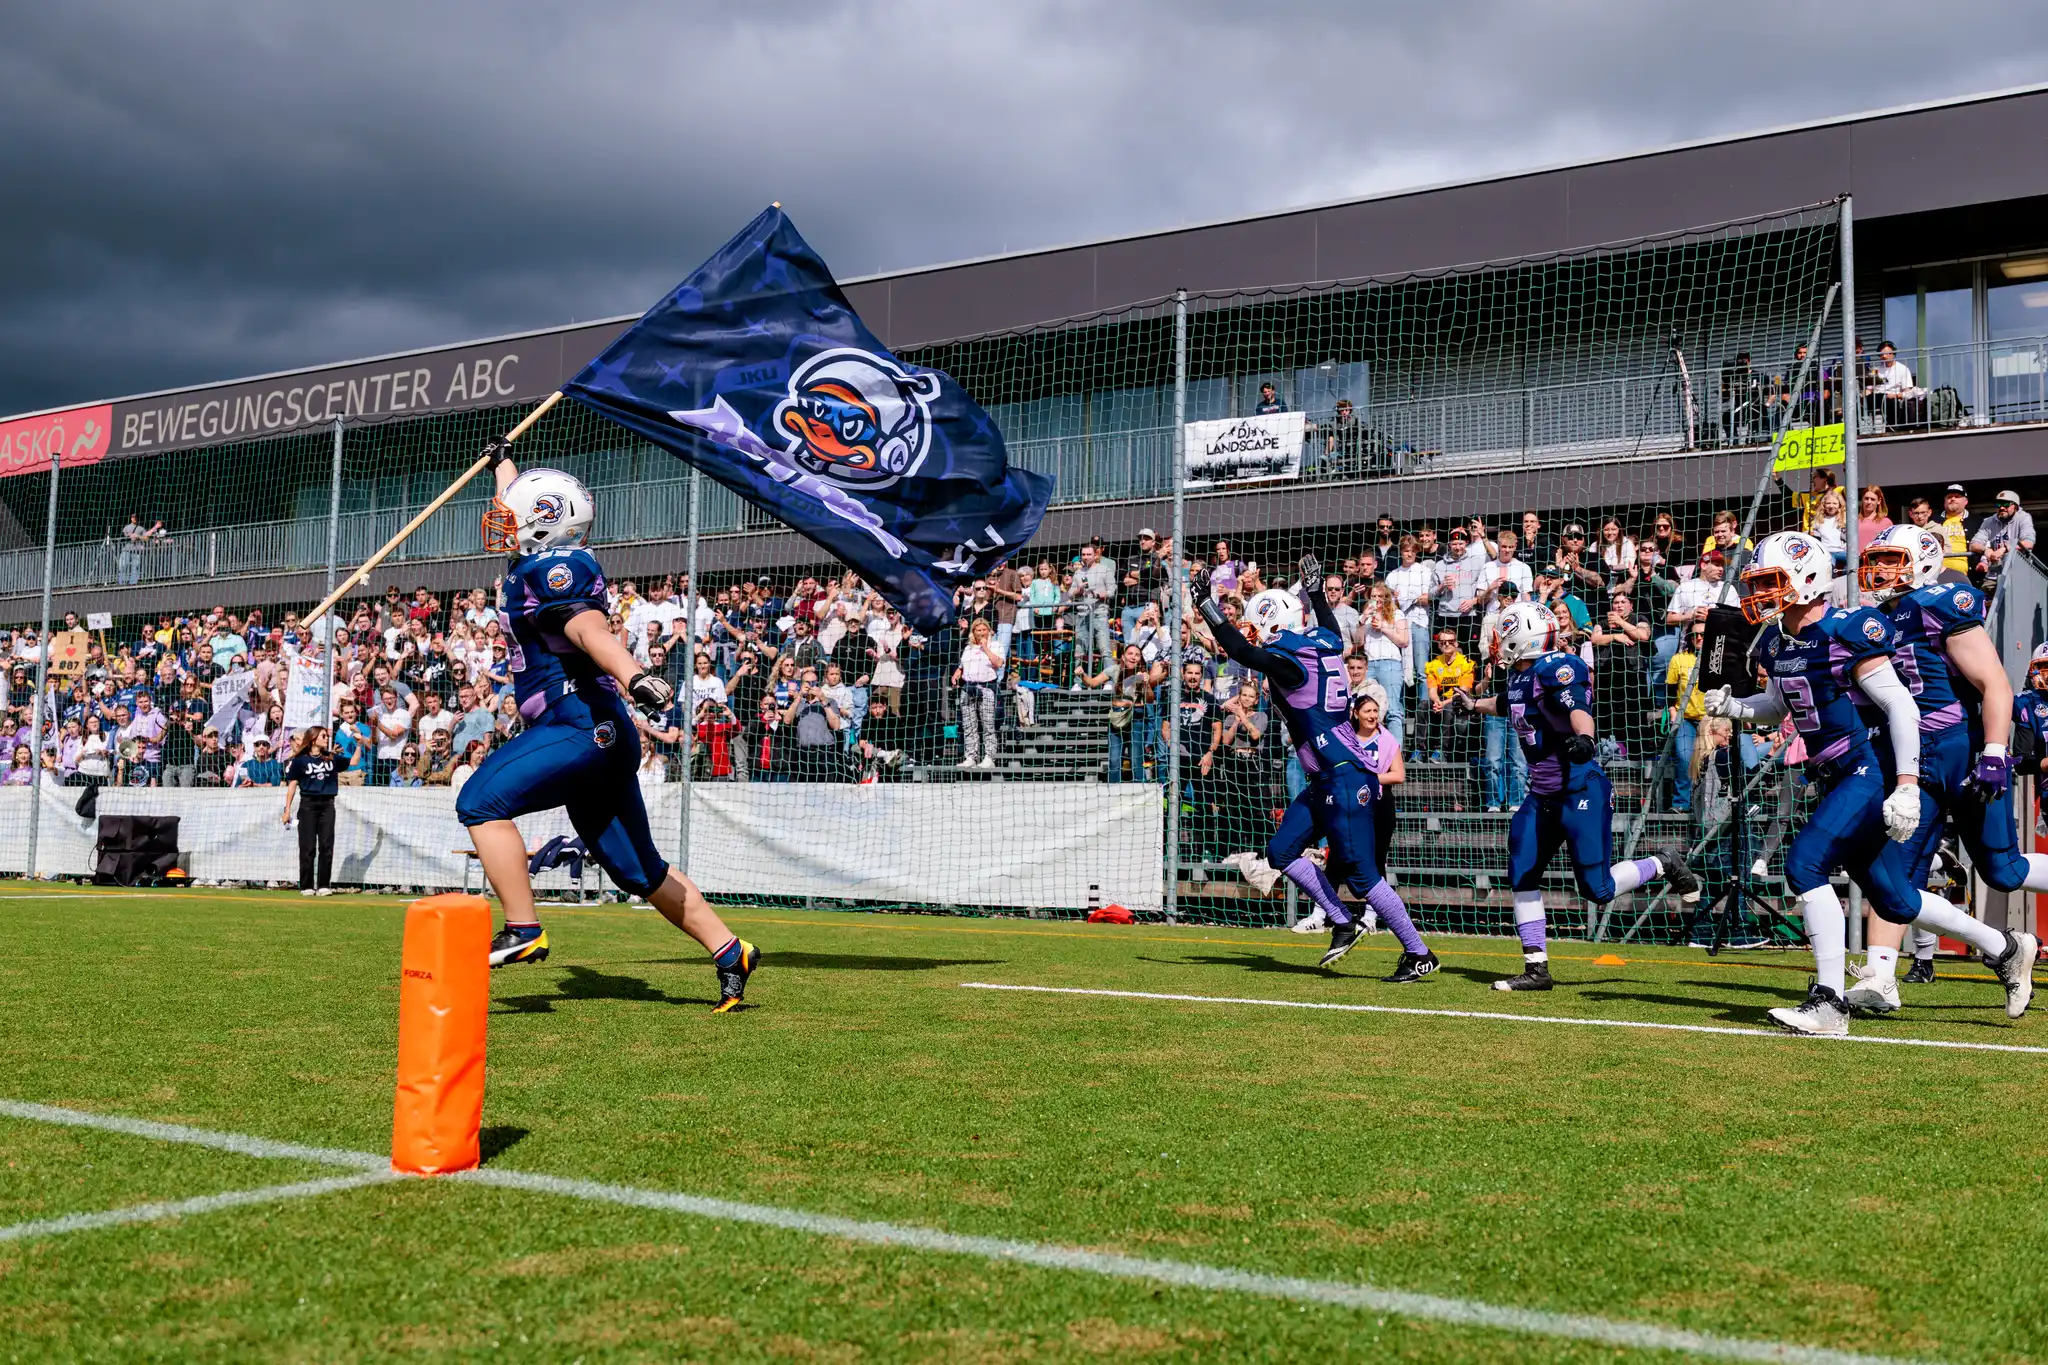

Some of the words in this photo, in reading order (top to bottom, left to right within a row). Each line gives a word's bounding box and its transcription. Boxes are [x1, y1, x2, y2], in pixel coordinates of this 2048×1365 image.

[735, 366, 778, 386] JKU
[122, 368, 431, 449] BEWEGUNGSCENTER
[445, 354, 519, 404] ABC
[0, 417, 66, 466] ASKÖ
[1237, 427, 1250, 440] DJ
[1205, 437, 1280, 456] LANDSCAPE
[1777, 440, 1799, 461] GO
[69, 636, 75, 645] I
[59, 661, 80, 670] #87
[305, 761, 334, 775] JKU
[404, 969, 432, 980] FORZA
